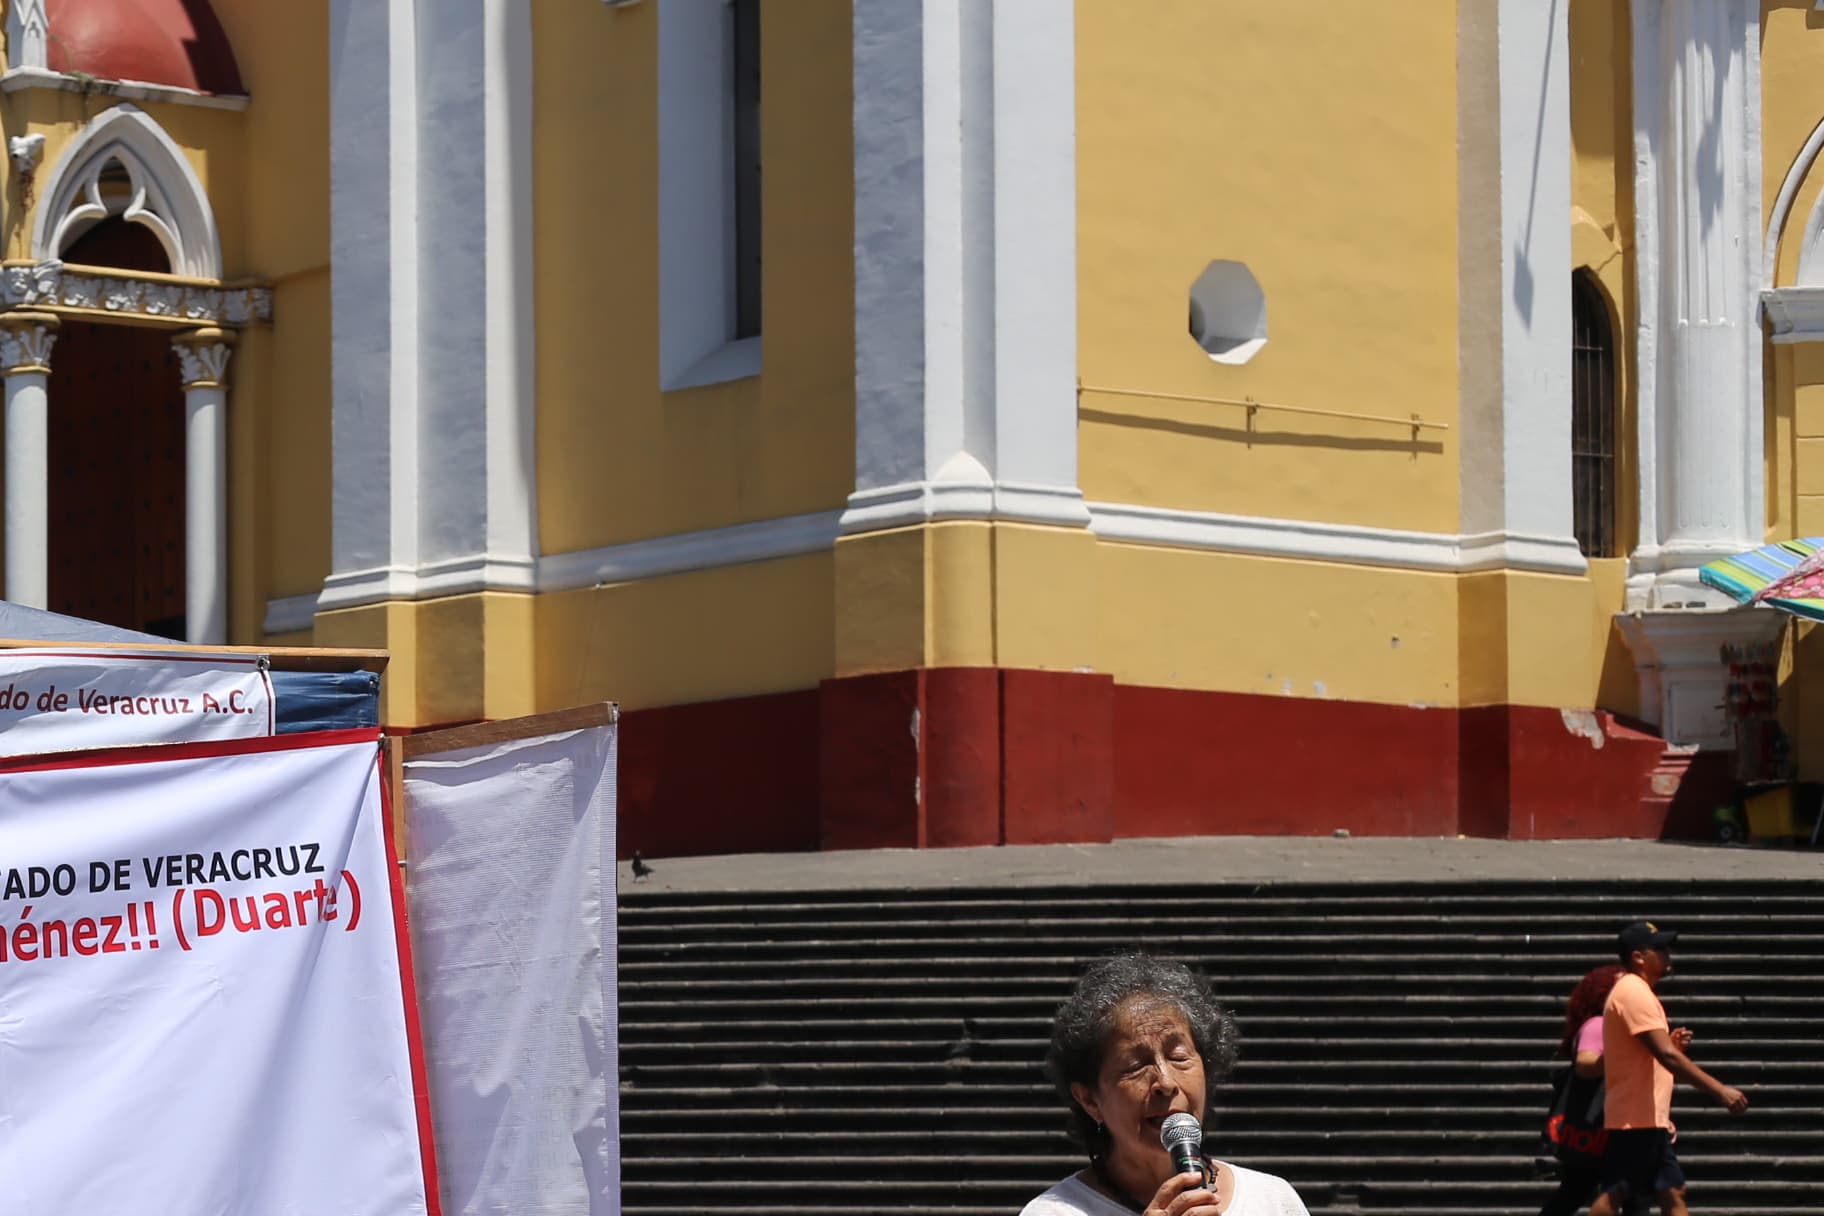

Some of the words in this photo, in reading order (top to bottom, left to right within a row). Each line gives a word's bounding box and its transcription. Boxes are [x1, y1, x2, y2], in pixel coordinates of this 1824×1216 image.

[37, 685, 68, 713] de
[78, 688, 194, 716] Veracruz
[201, 689, 254, 716] A.C.
[89, 860, 131, 895] DE
[142, 843, 325, 888] VERACRUZ
